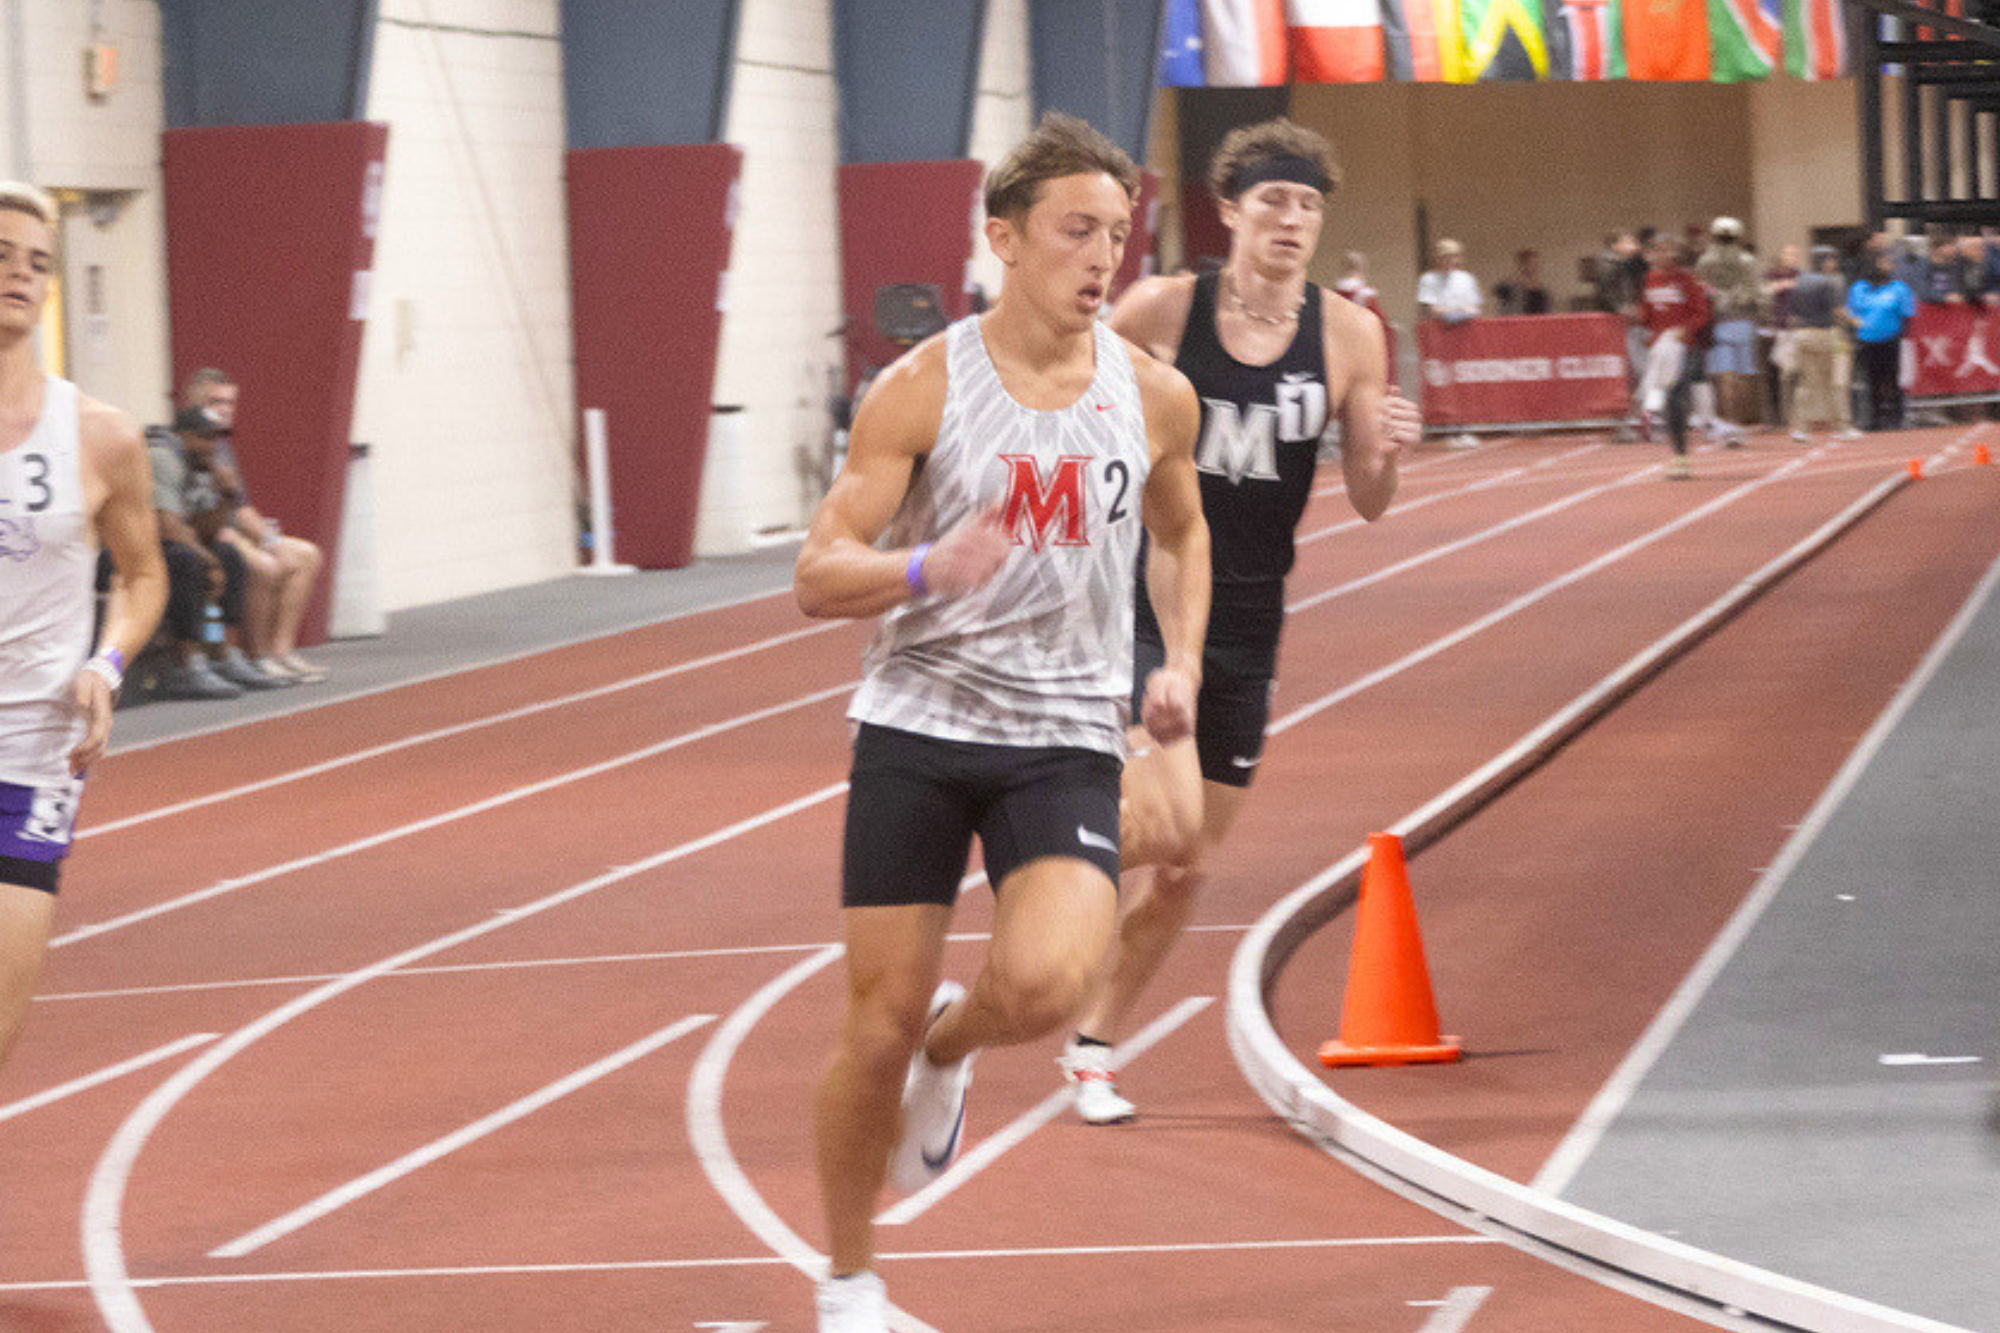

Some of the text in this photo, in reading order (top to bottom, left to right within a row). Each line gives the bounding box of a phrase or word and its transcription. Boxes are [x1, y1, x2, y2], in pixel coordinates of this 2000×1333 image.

[1195, 396, 1281, 486] M
[22, 453, 53, 512] 3
[997, 454, 1094, 553] M
[1103, 459, 1130, 524] 2
